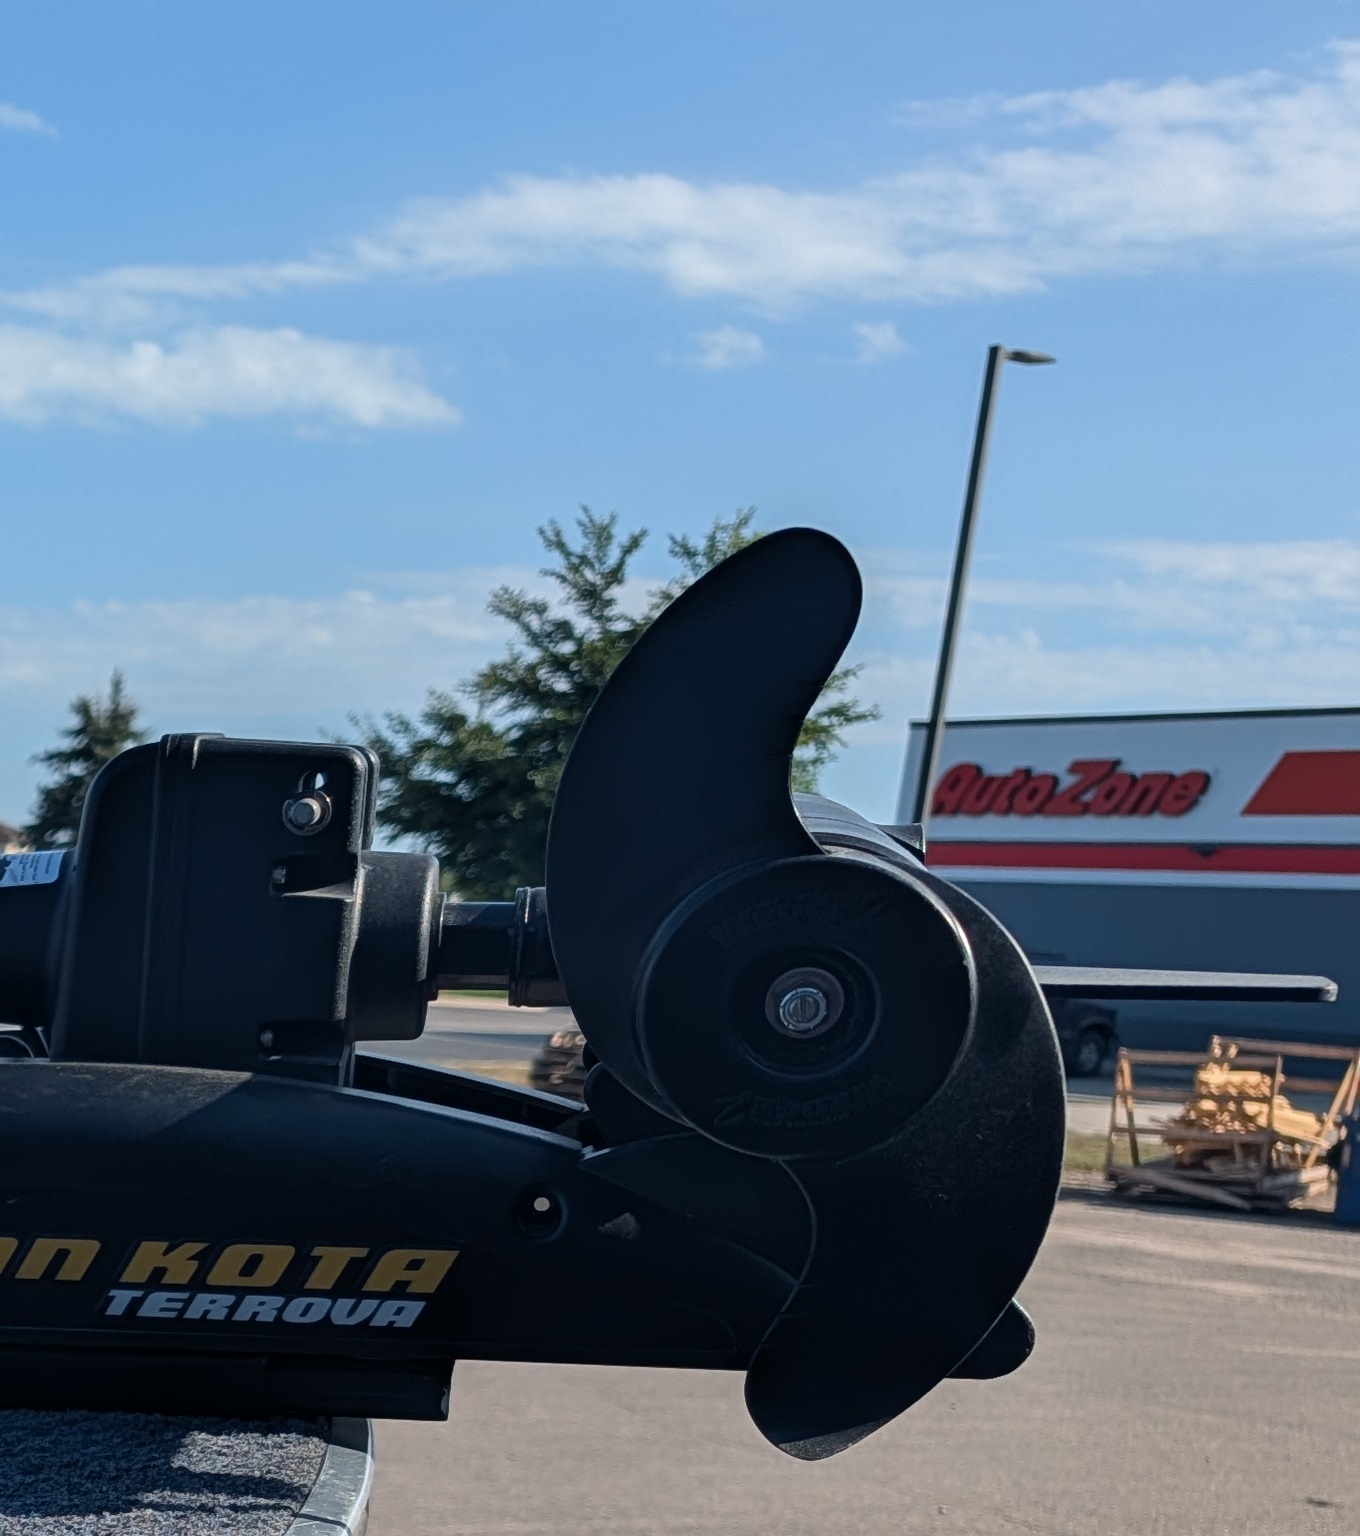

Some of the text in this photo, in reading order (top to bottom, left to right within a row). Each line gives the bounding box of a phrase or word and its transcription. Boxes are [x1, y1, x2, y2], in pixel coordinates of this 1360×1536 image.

[930, 758, 1211, 817] AutoZone
[118, 1241, 461, 1293] KOTA
[104, 1289, 426, 1328] TERROVA
